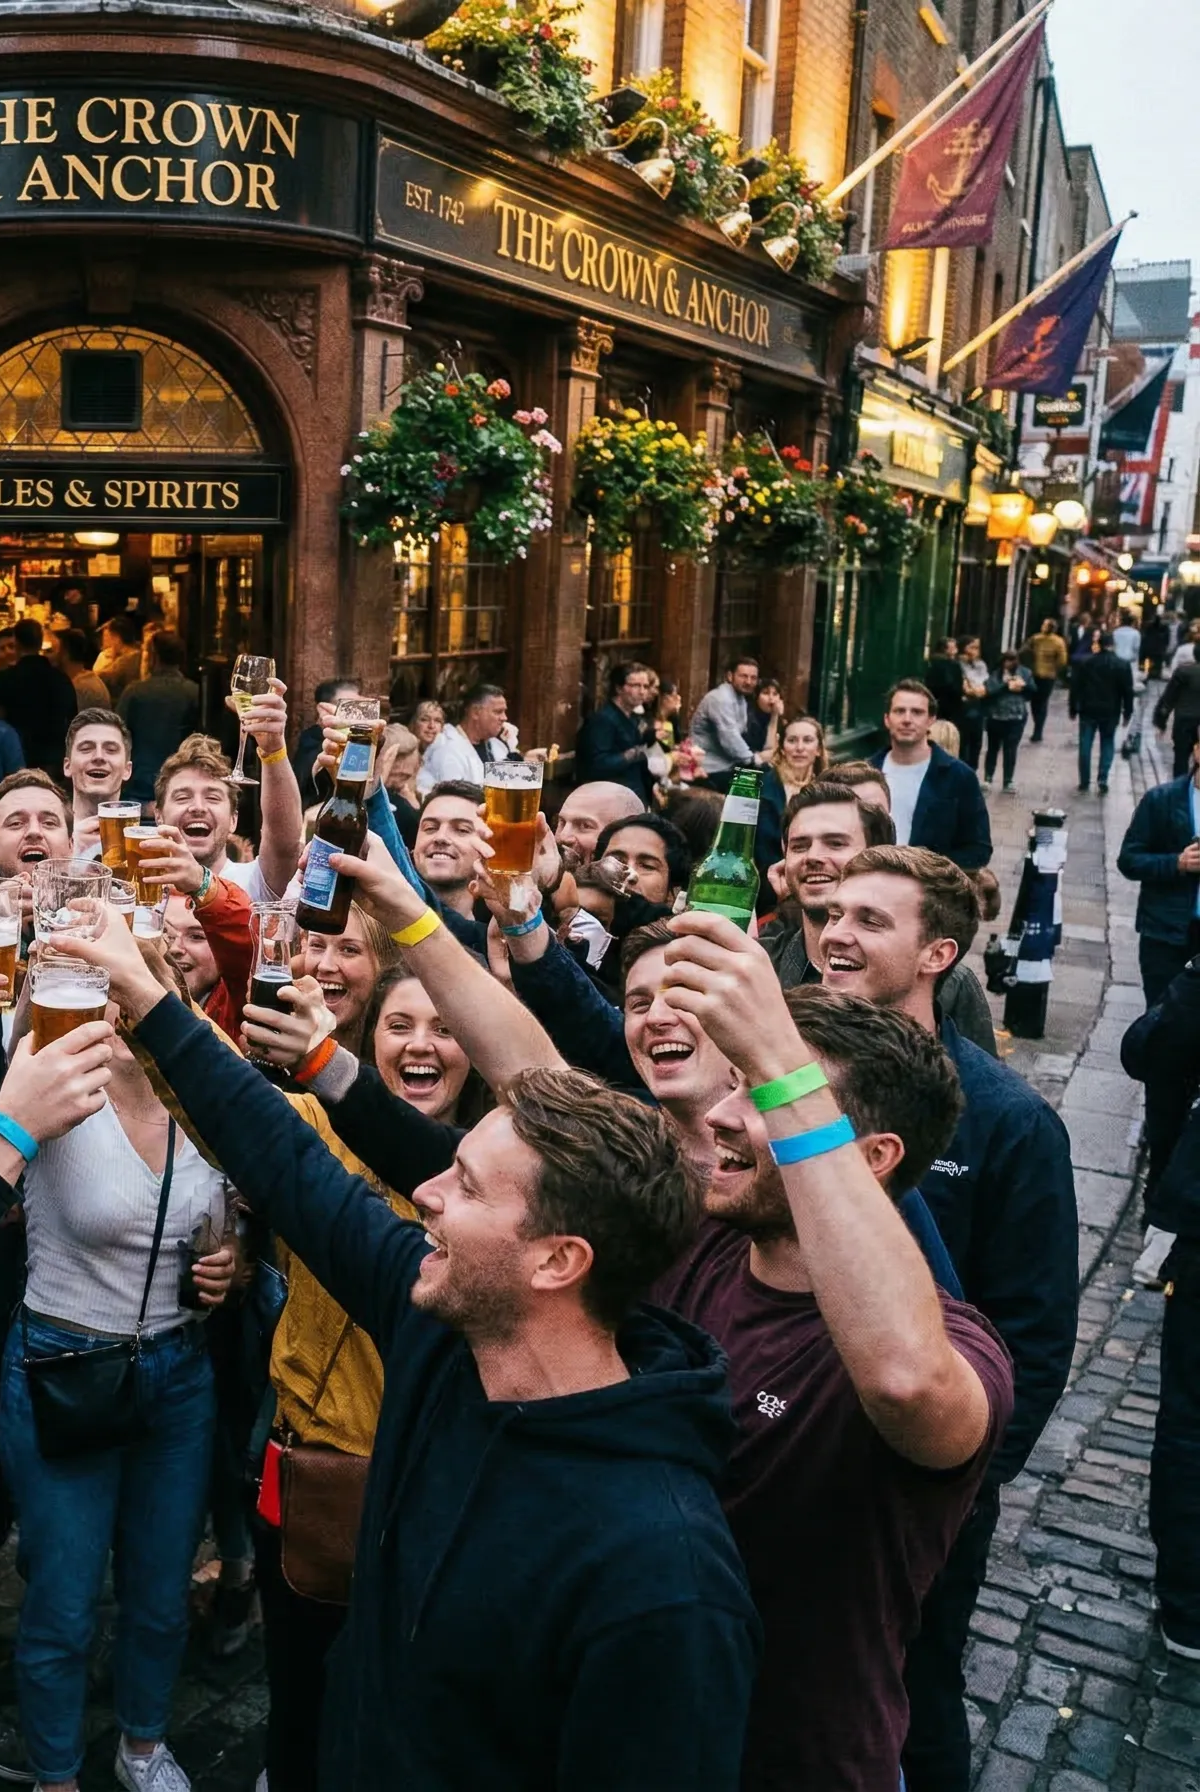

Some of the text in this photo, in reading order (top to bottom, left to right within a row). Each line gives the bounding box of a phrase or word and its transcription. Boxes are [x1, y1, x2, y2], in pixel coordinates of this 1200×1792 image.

[77, 97, 300, 159] CROWN
[16, 154, 280, 211] ANCHOR
[405, 181, 466, 226] EST. 1742
[494, 199, 770, 348] THE CROWN & ANCHOR
[64, 479, 97, 508] &
[104, 480, 240, 510] SPIRITS
